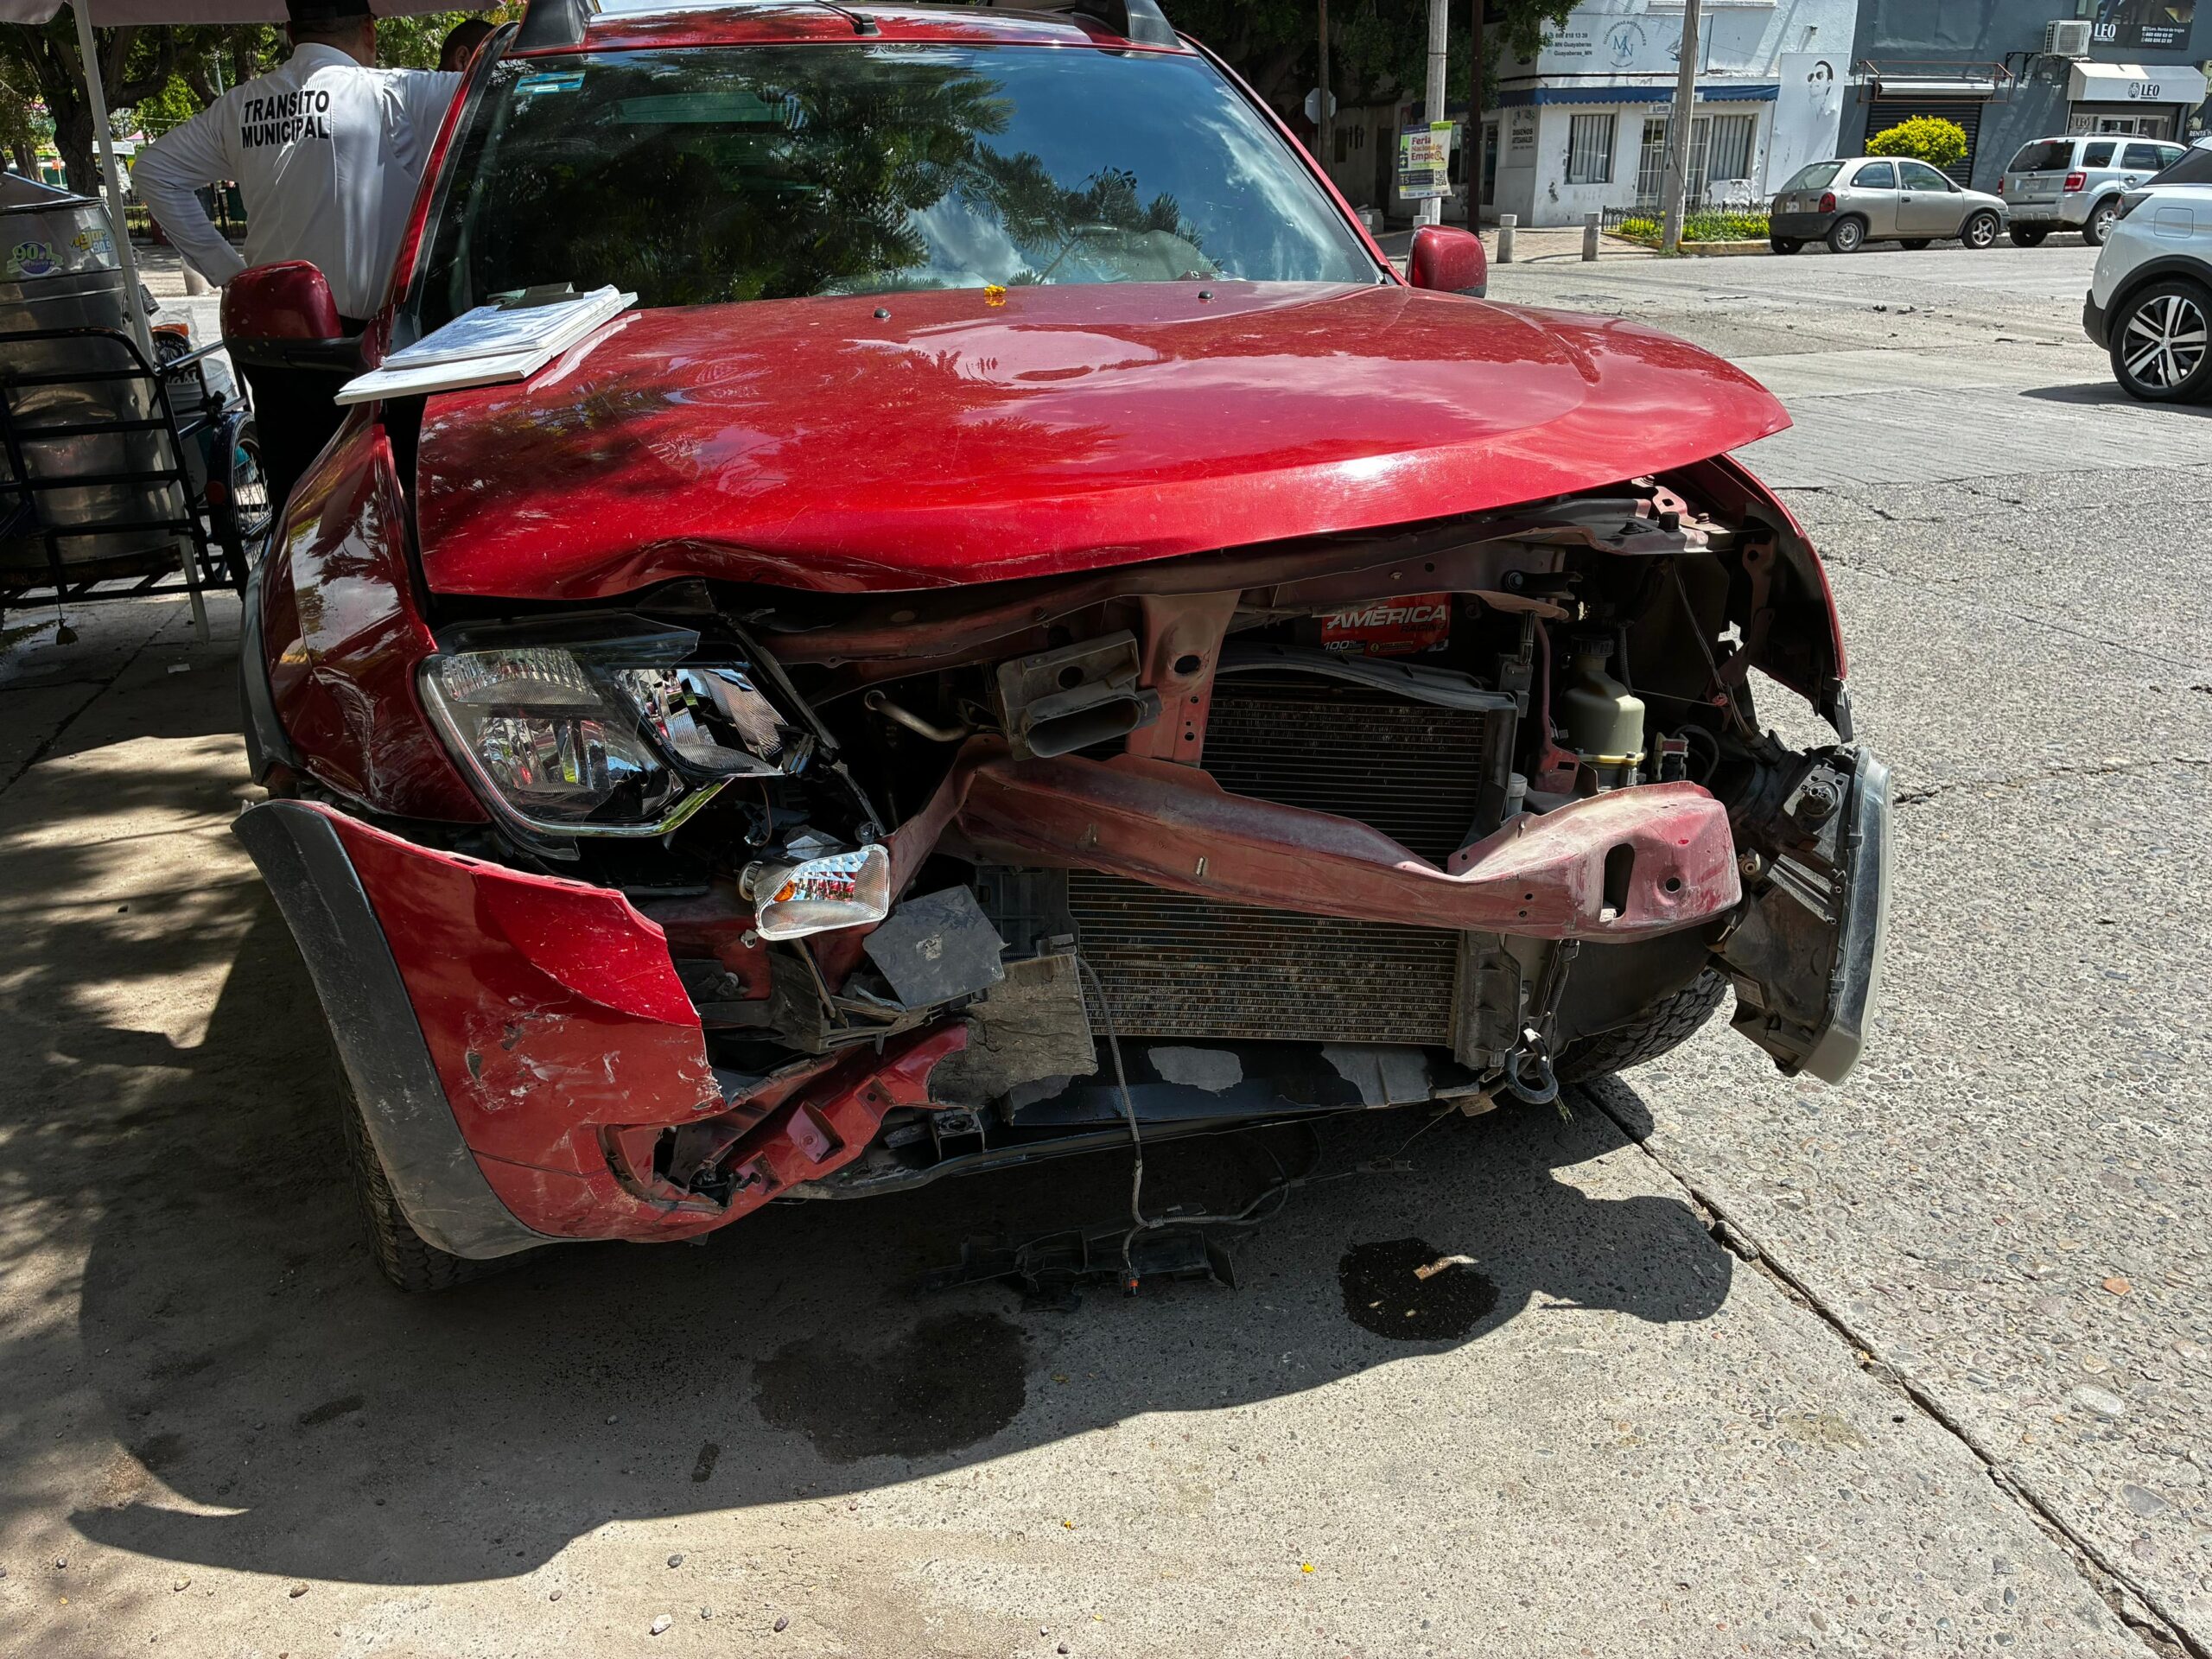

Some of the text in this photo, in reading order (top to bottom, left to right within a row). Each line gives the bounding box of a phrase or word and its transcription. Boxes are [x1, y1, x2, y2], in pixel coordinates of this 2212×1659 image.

[2094, 23, 2116, 38] LEO
[2140, 84, 2160, 96] LEO
[245, 90, 330, 124] TRANSITO
[2075, 118, 2089, 128] LEO
[241, 116, 329, 149] MUNICIPAL
[1412, 136, 1431, 145] Feria
[1411, 143, 1435, 152] Nacional
[1401, 175, 1409, 184] 15
[1400, 622, 1446, 633] RACING
[1324, 640, 1349, 651] 100
